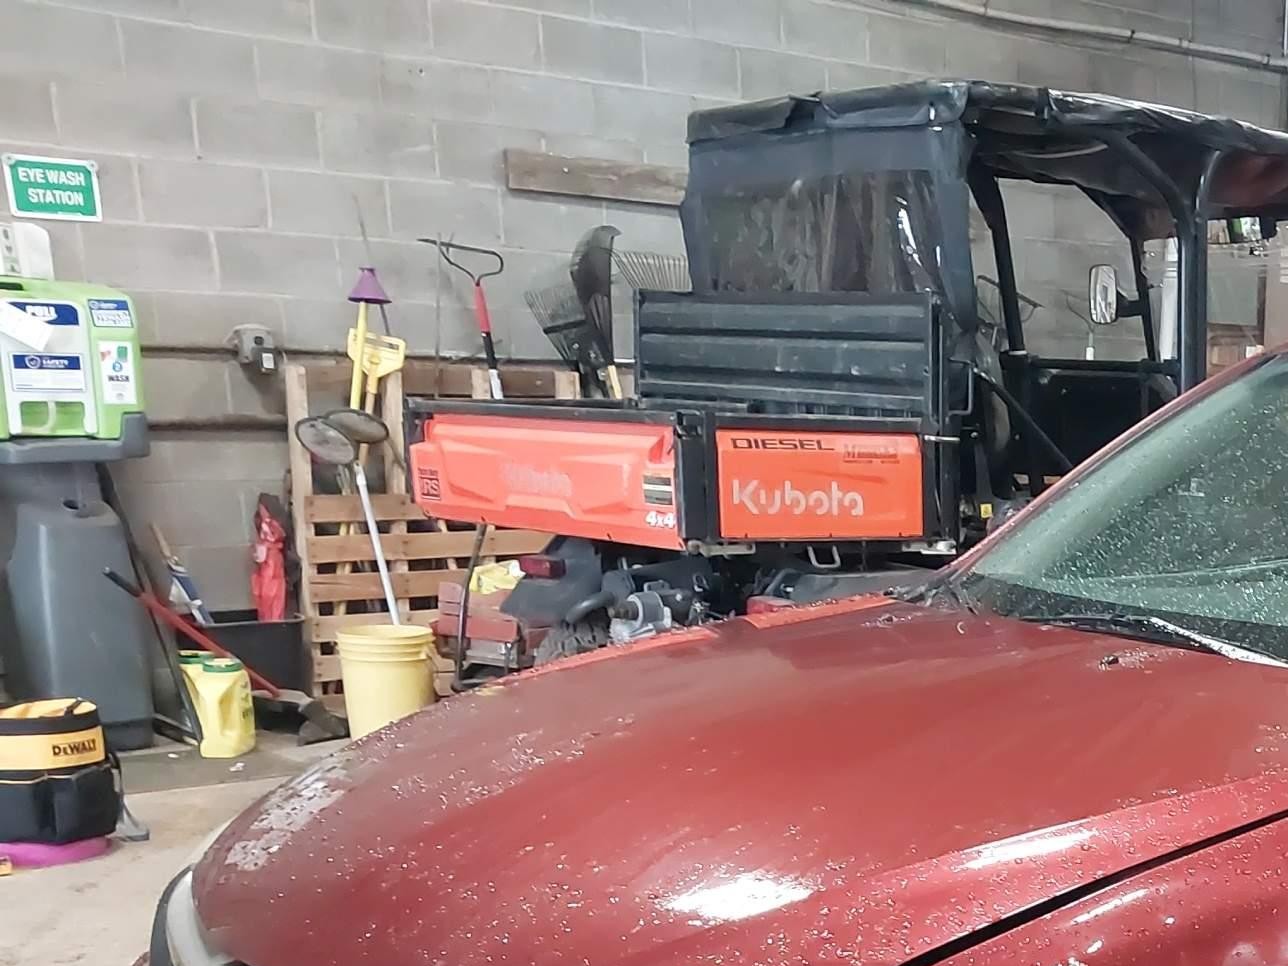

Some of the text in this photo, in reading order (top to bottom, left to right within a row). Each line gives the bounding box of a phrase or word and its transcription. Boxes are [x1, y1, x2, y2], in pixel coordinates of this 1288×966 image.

[17, 166, 86, 187] EYE WASH
[28, 188, 84, 206] STATION
[731, 438, 834, 451] DIESEL
[732, 479, 865, 516] Kubota
[645, 511, 675, 529] 4x4
